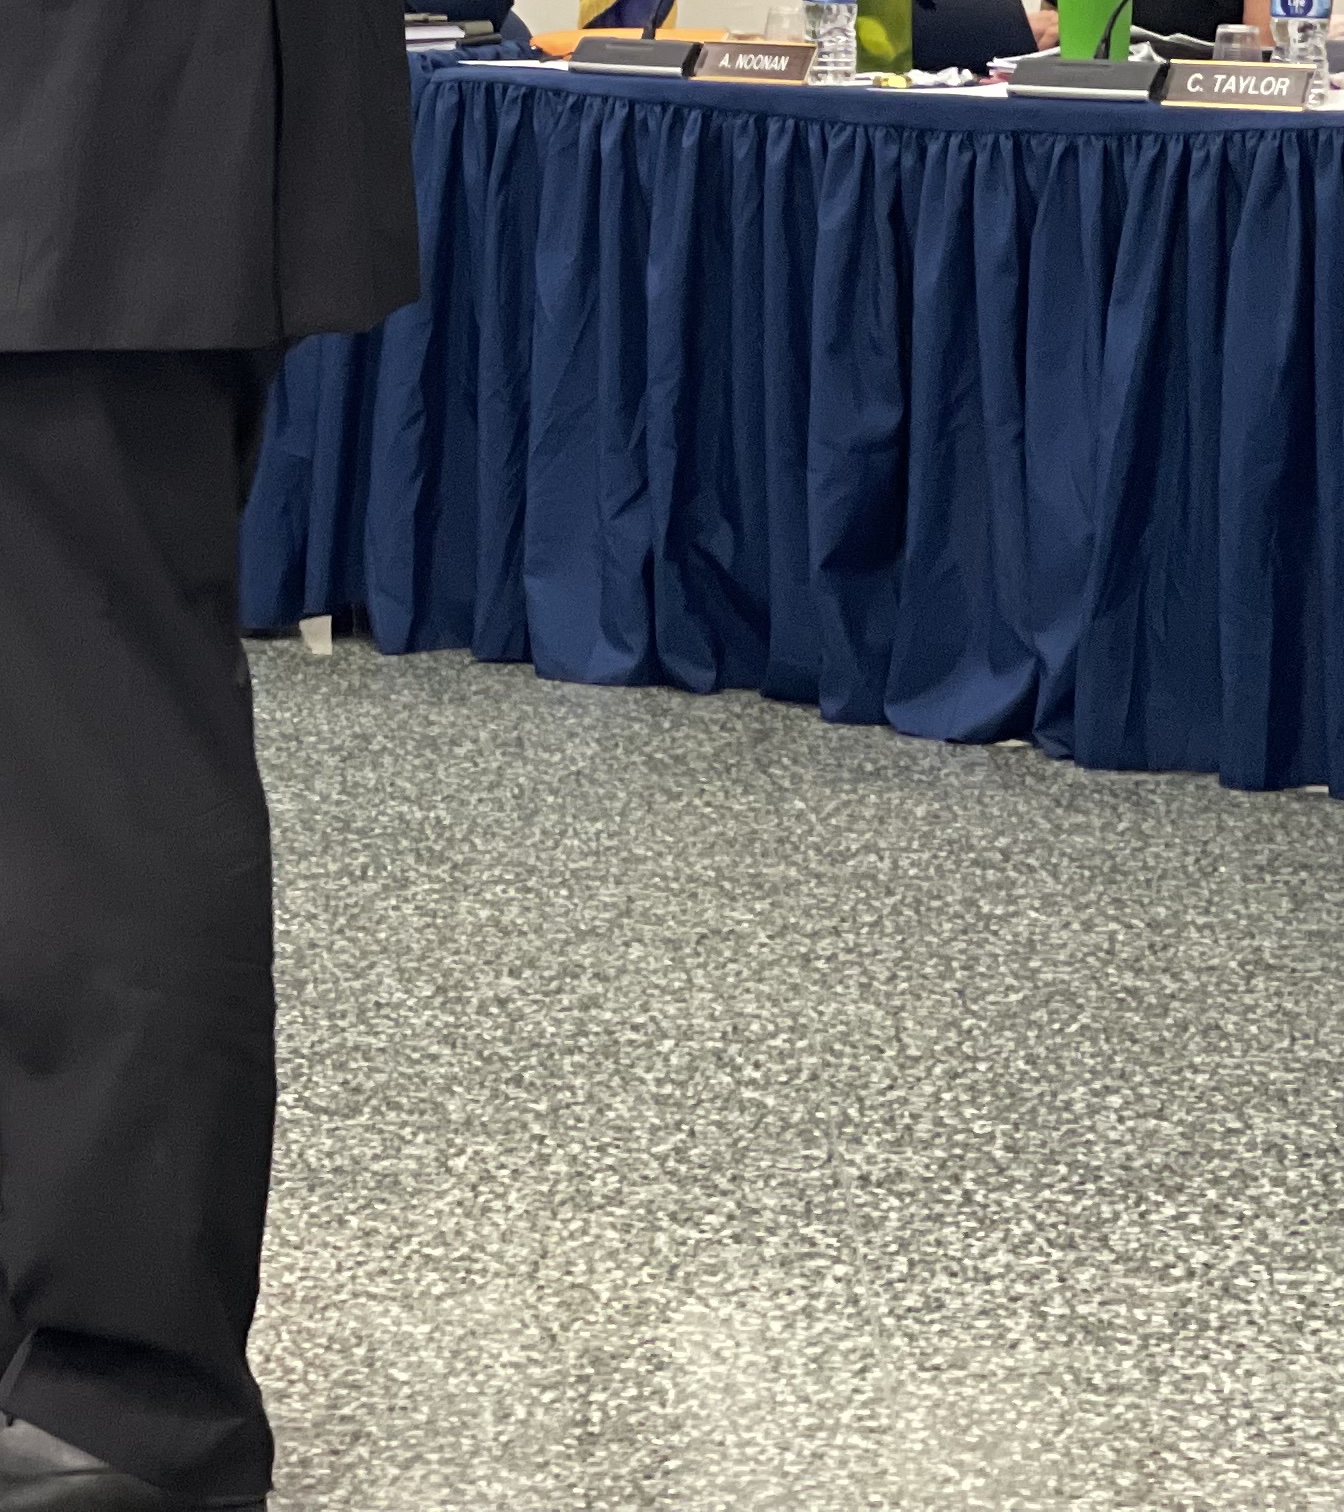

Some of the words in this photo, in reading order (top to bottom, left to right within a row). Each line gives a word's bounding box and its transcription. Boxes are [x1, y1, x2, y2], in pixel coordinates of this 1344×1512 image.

[719, 54, 731, 68] A.
[736, 54, 789, 71] NOONAN
[1187, 73, 1204, 92] C.
[1213, 74, 1290, 96] TAYLOR
